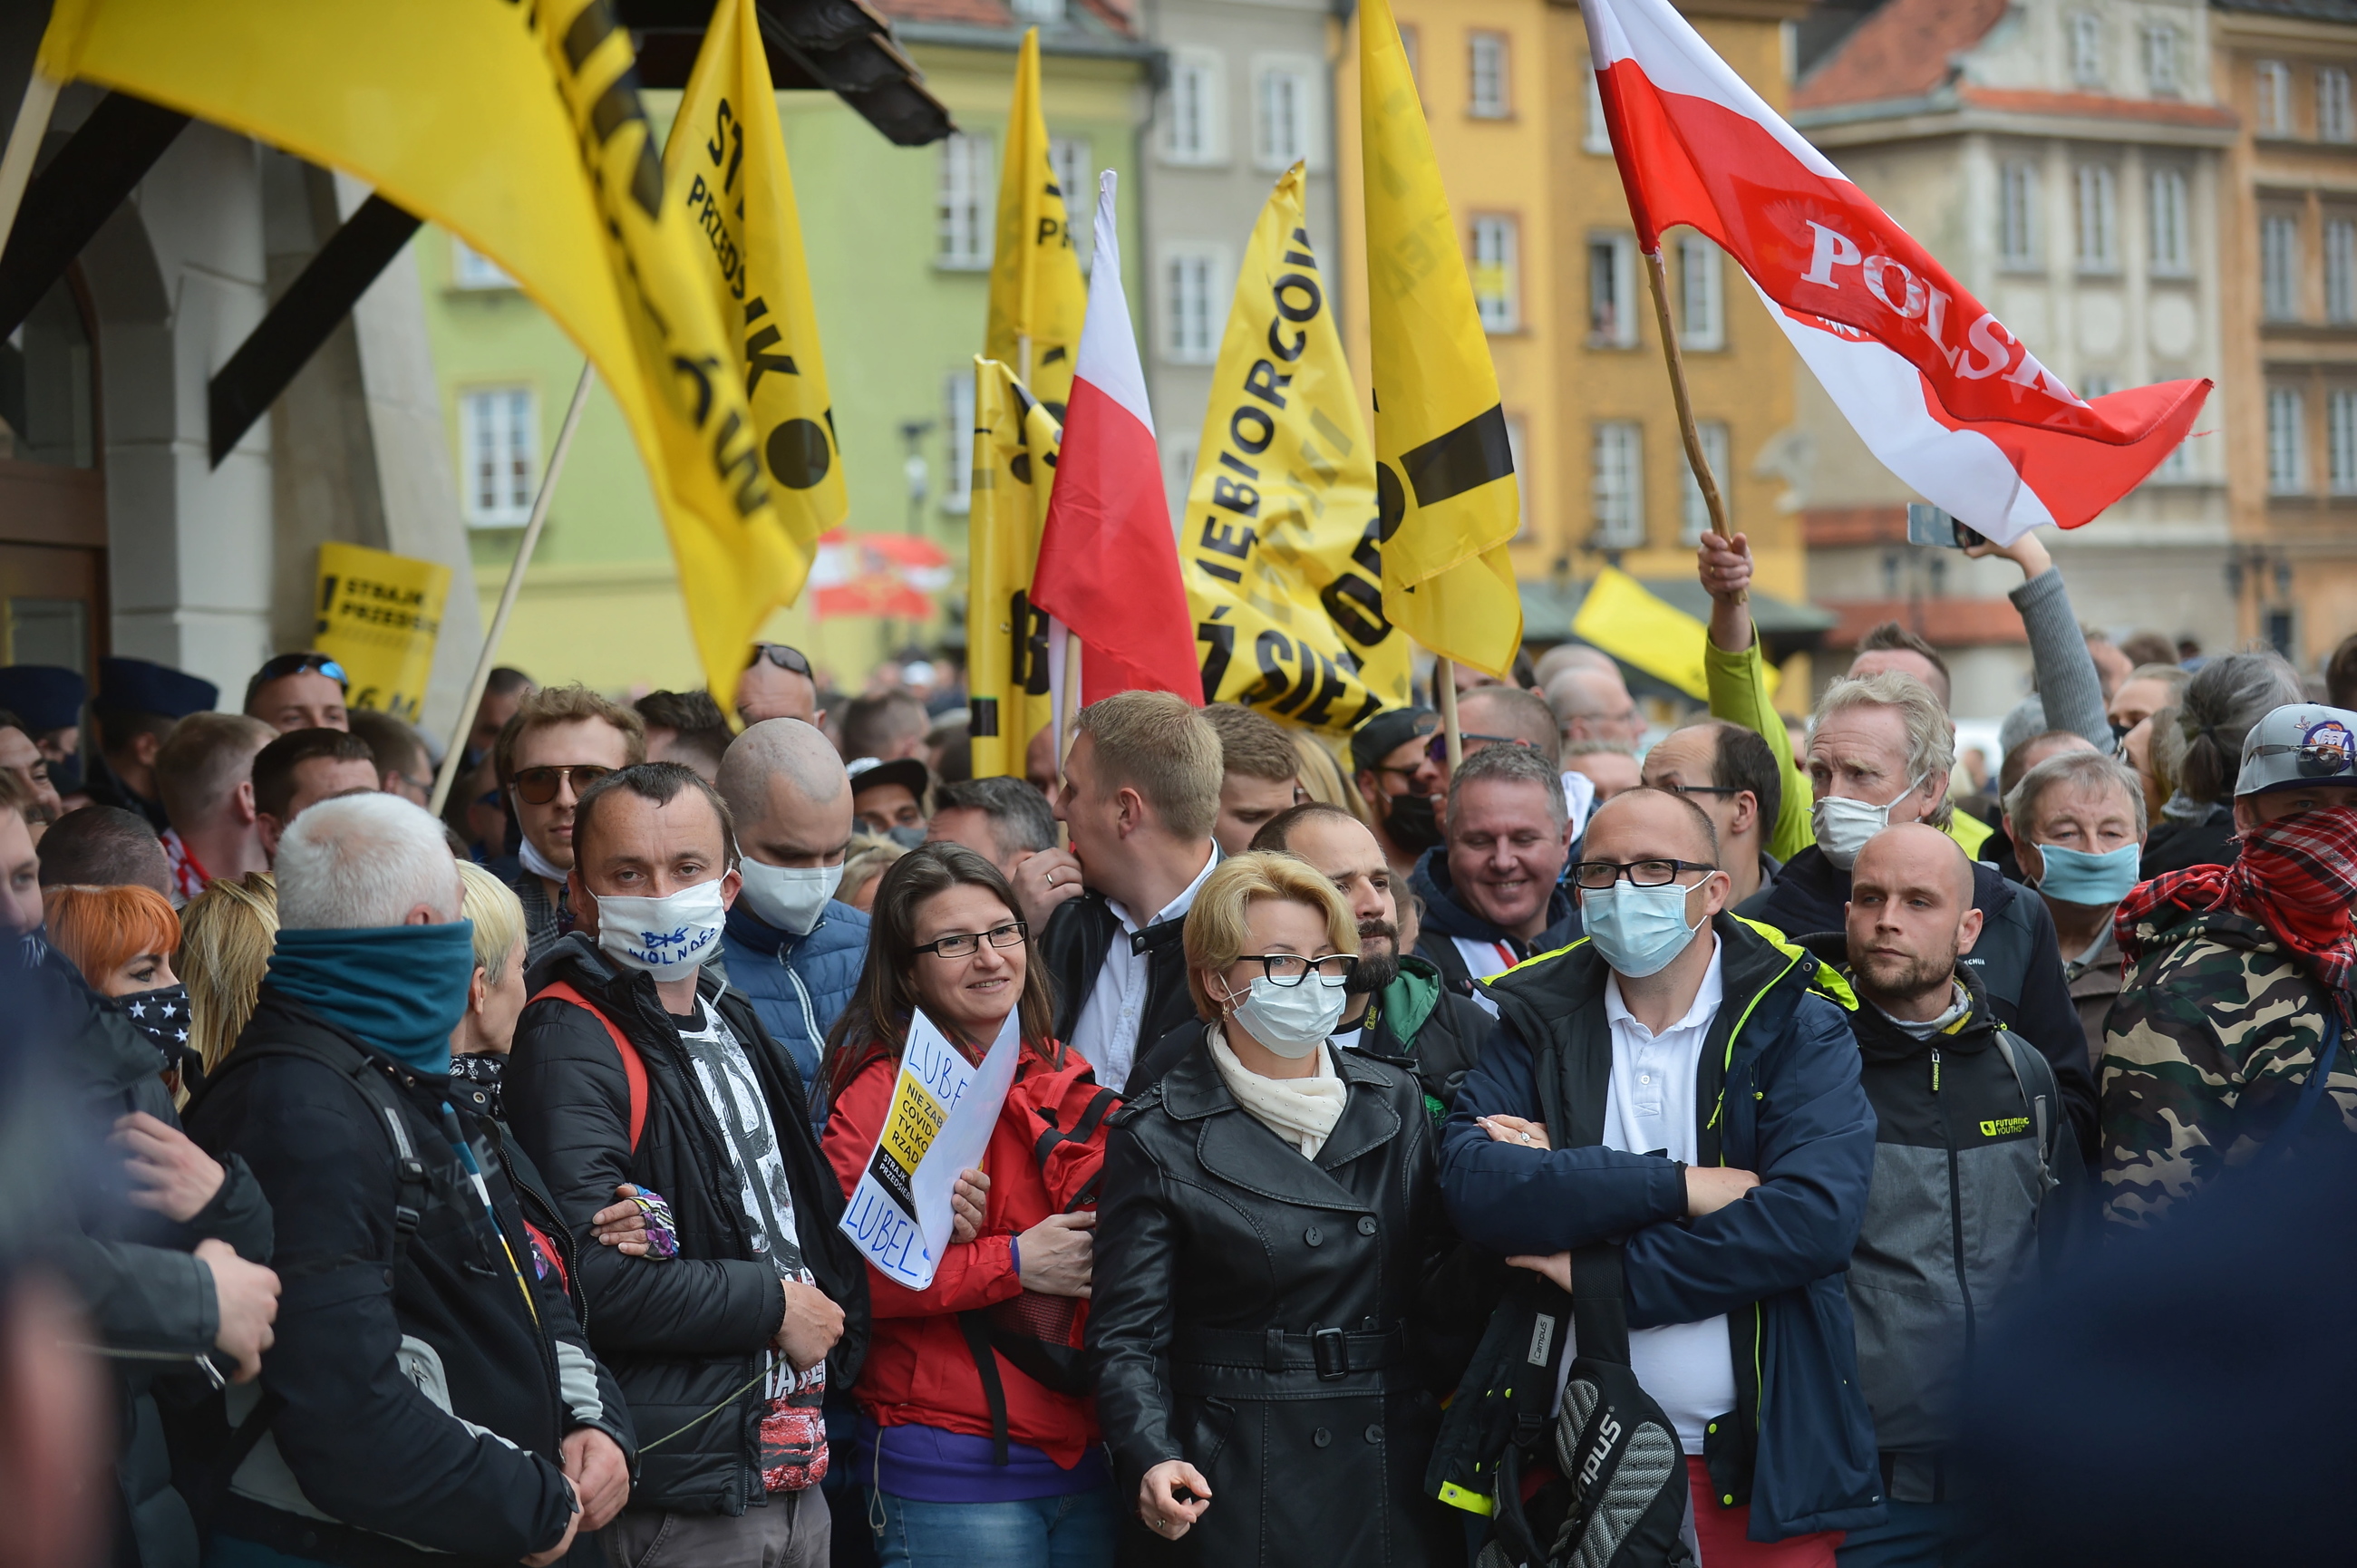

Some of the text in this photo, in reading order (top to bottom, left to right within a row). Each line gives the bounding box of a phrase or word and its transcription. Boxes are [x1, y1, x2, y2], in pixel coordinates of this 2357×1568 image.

[1800, 219, 2093, 410] POLSK
[907, 1083, 924, 1107] NIE
[898, 1114, 929, 1153] TYLKO
[902, 1100, 935, 1138] COVID-
[892, 1130, 922, 1164] RZĄD
[883, 1154, 907, 1182] STRAJK
